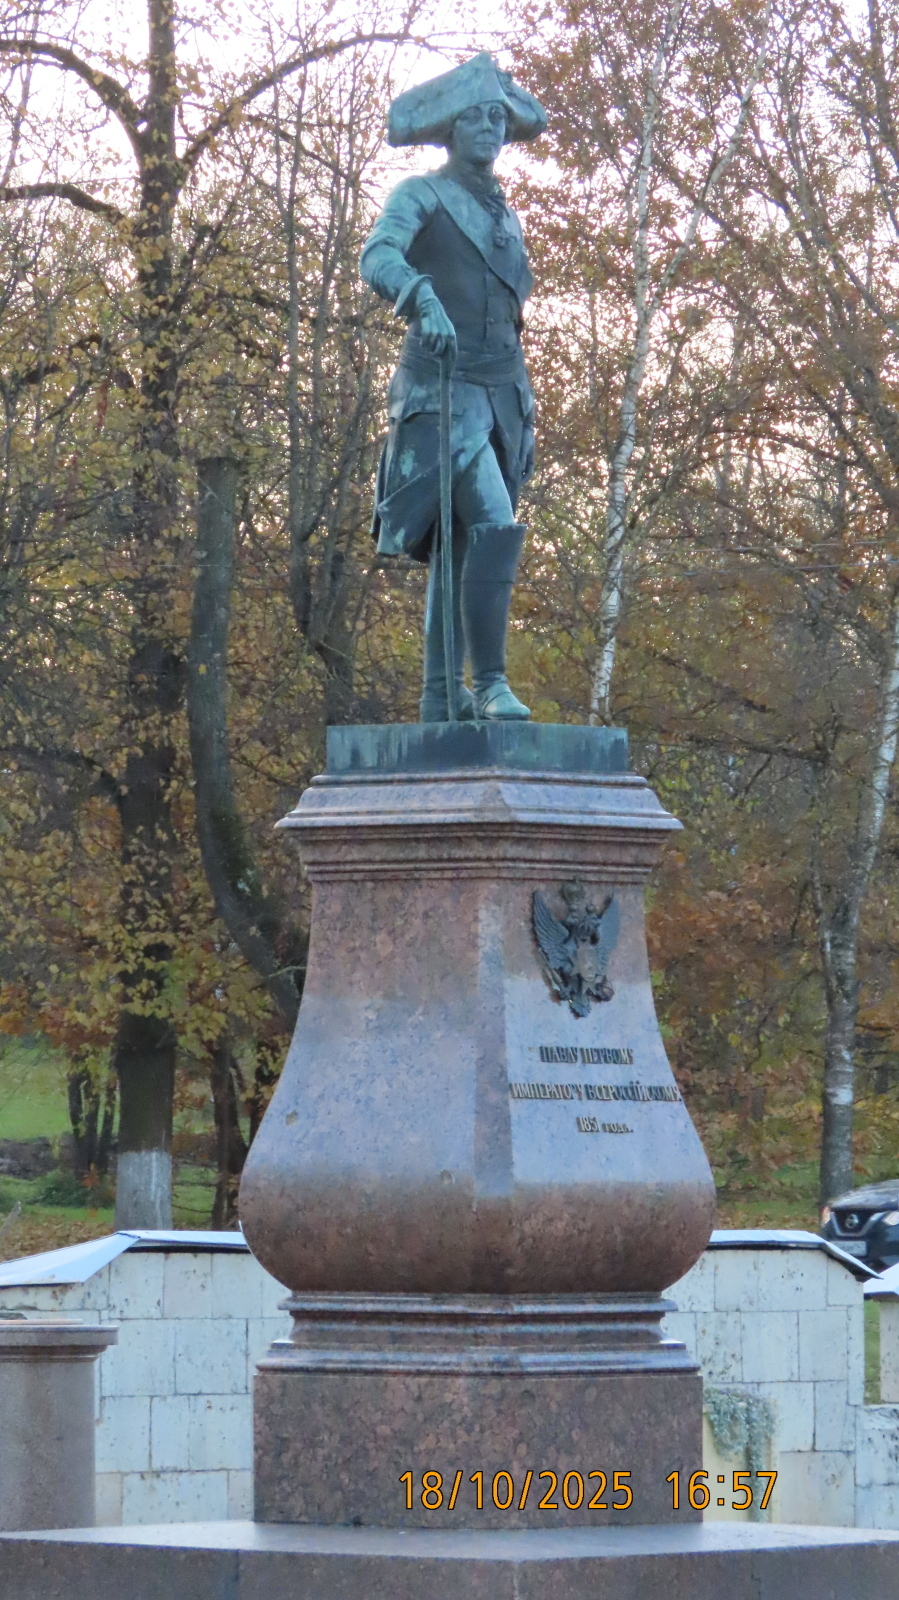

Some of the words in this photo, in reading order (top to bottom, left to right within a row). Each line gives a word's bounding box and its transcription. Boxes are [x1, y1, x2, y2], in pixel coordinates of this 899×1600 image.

[540, 1046, 579, 1063] ПАВЛУ
[581, 1047, 634, 1065] ПЕРВОМУ
[510, 1082, 583, 1101] ИМПЕРАТОРУ
[577, 1116, 600, 1133] 1851
